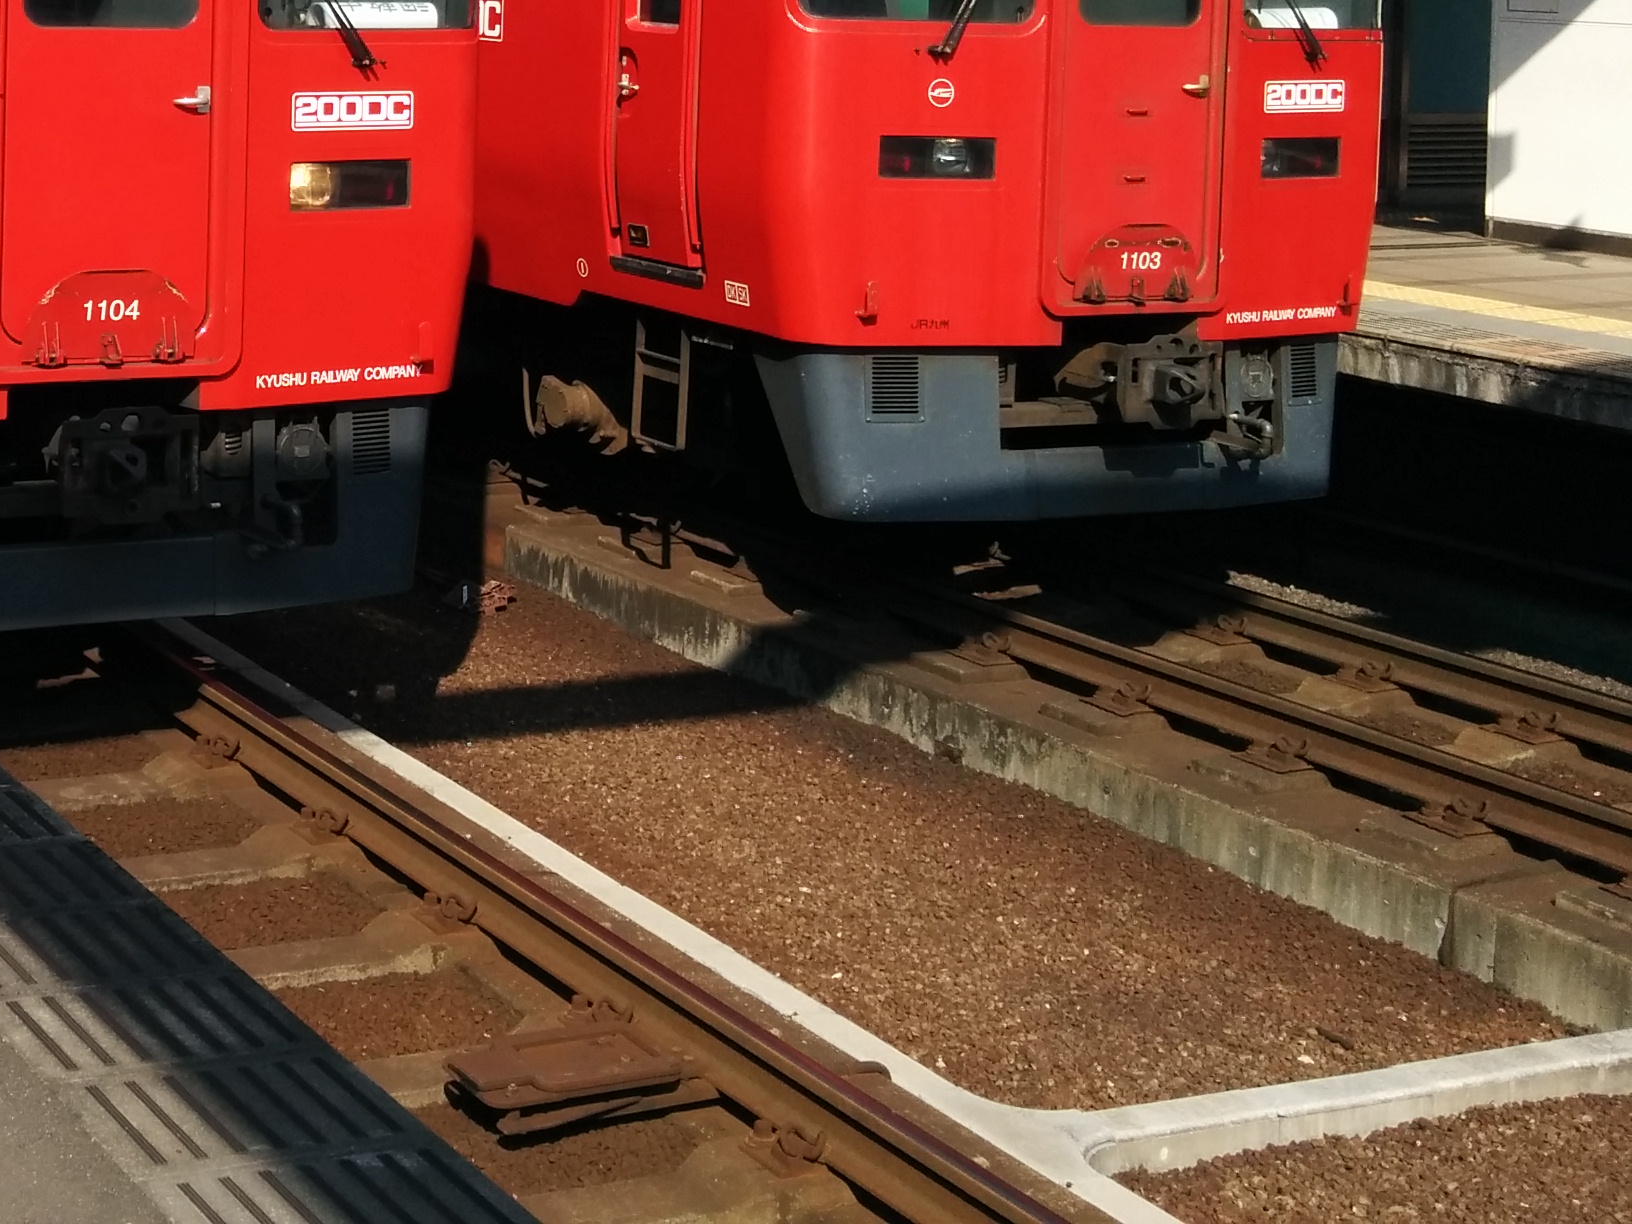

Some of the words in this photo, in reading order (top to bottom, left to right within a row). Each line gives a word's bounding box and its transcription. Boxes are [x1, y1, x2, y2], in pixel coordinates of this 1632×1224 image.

[1266, 83, 1343, 106] 200DC
[295, 95, 410, 123] 200DC
[1120, 251, 1162, 270] 1103
[82, 299, 141, 322] 1104
[1225, 311, 1261, 325] KYUSHU
[1262, 308, 1296, 322] RAILWAY
[1297, 306, 1337, 320] COMPANY
[255, 371, 307, 389] KYUSHU
[310, 368, 361, 385] RAILWAY
[364, 364, 423, 381] COMPANY
